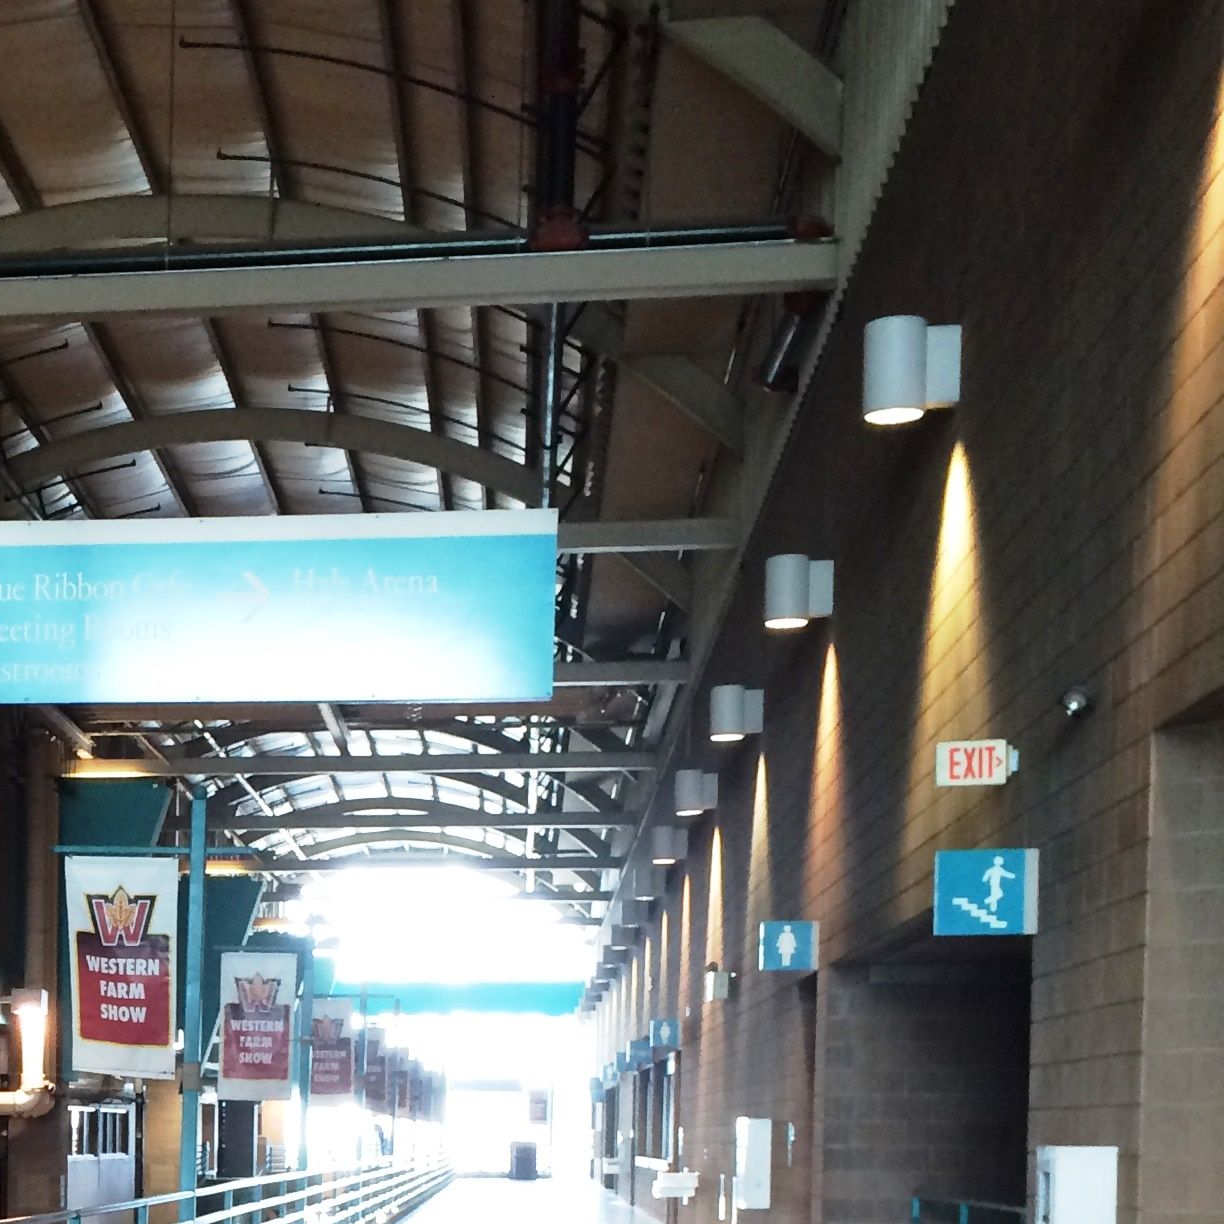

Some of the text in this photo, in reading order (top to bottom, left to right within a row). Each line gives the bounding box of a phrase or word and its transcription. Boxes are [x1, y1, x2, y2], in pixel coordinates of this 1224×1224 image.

[33, 570, 125, 601] Ribbon
[359, 566, 439, 594] Arena
[948, 746, 996, 780] EXIT
[85, 954, 160, 976] WESTERN
[99, 980, 146, 999] FARM
[100, 1003, 147, 1023] SHOW
[230, 1019, 284, 1032] WESTERN
[239, 1035, 273, 1047] FARM
[238, 1052, 273, 1064] SHOW
